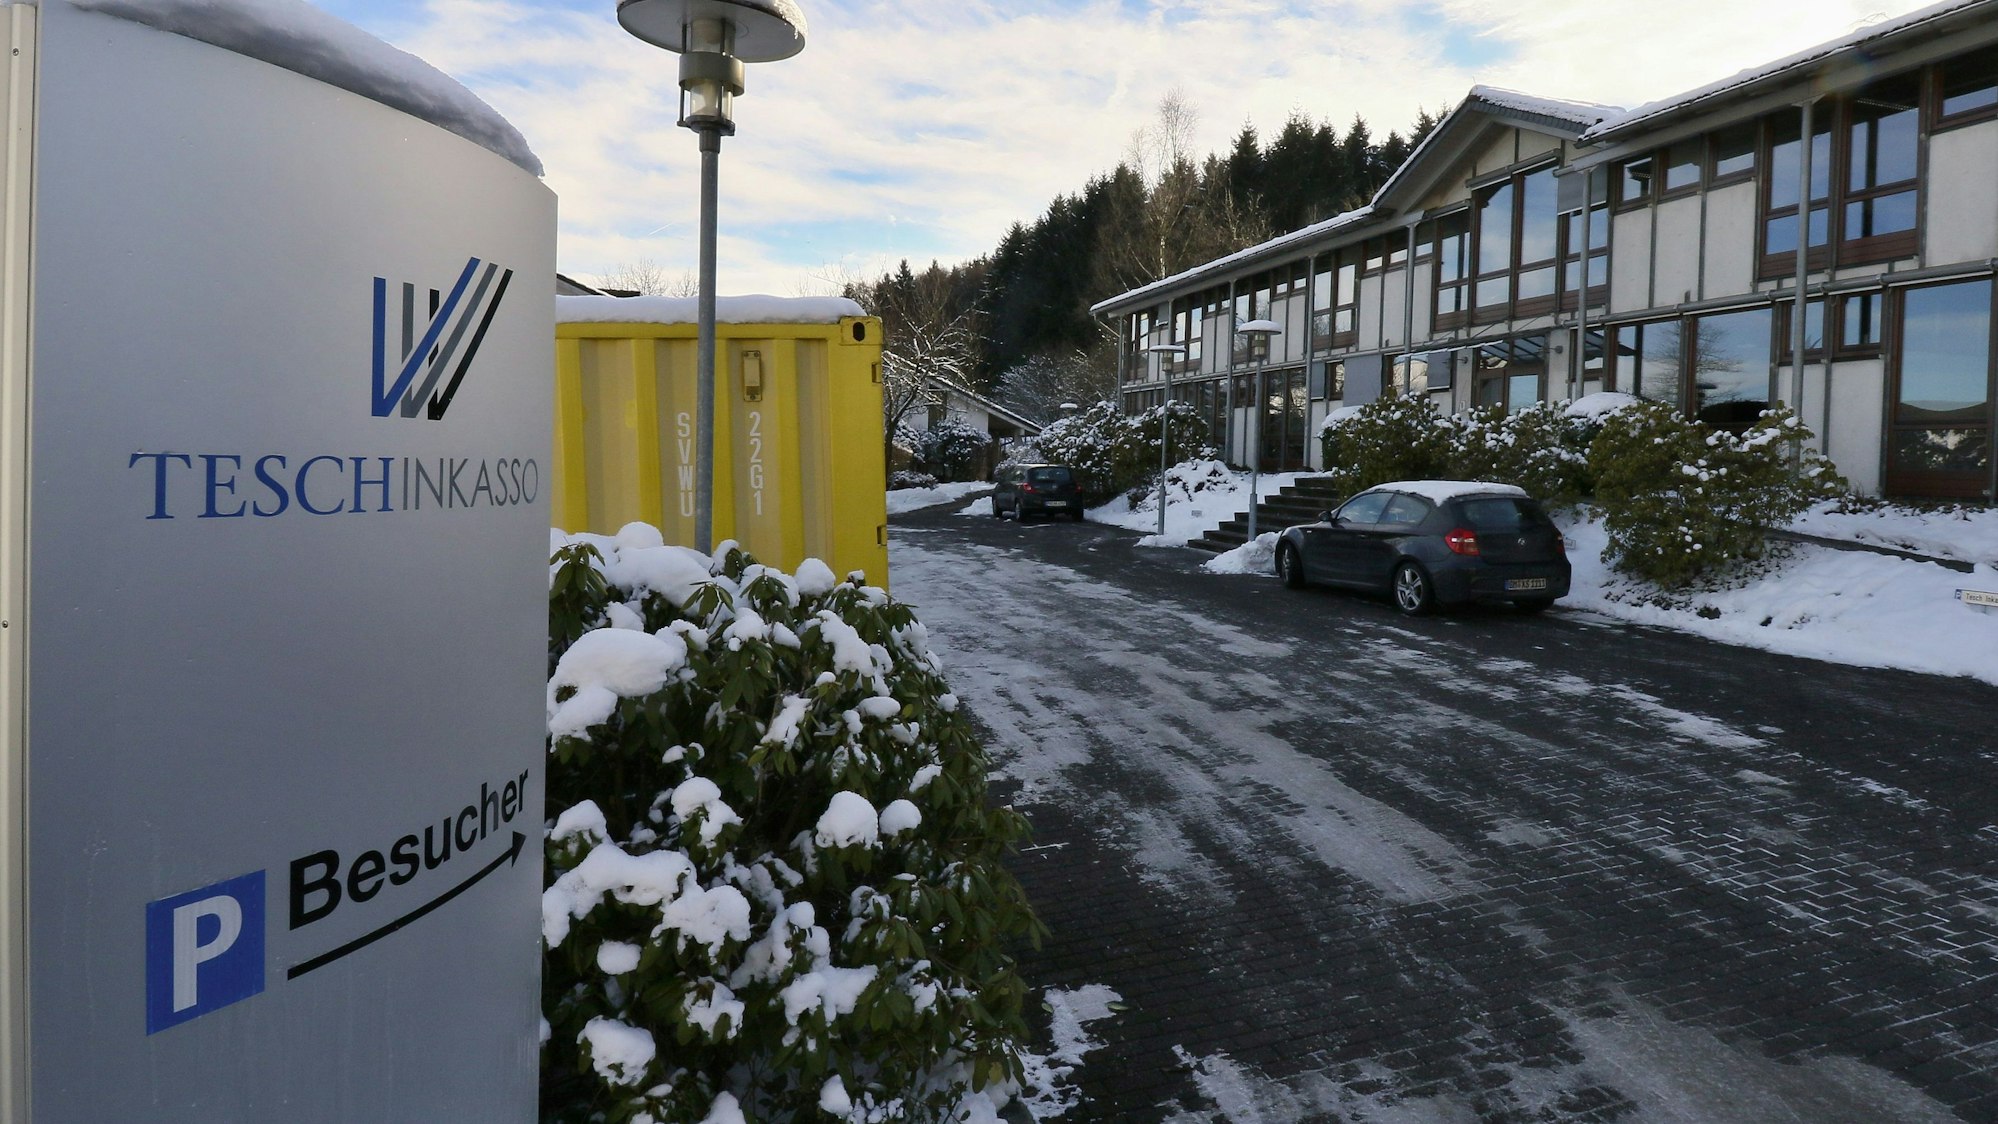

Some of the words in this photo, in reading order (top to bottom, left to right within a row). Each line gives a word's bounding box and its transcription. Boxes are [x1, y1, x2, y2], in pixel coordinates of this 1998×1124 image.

[677, 412, 694, 517] SVWU
[749, 411, 763, 515] 22G1
[173, 894, 243, 1014] P
[289, 768, 528, 931] Besucher
